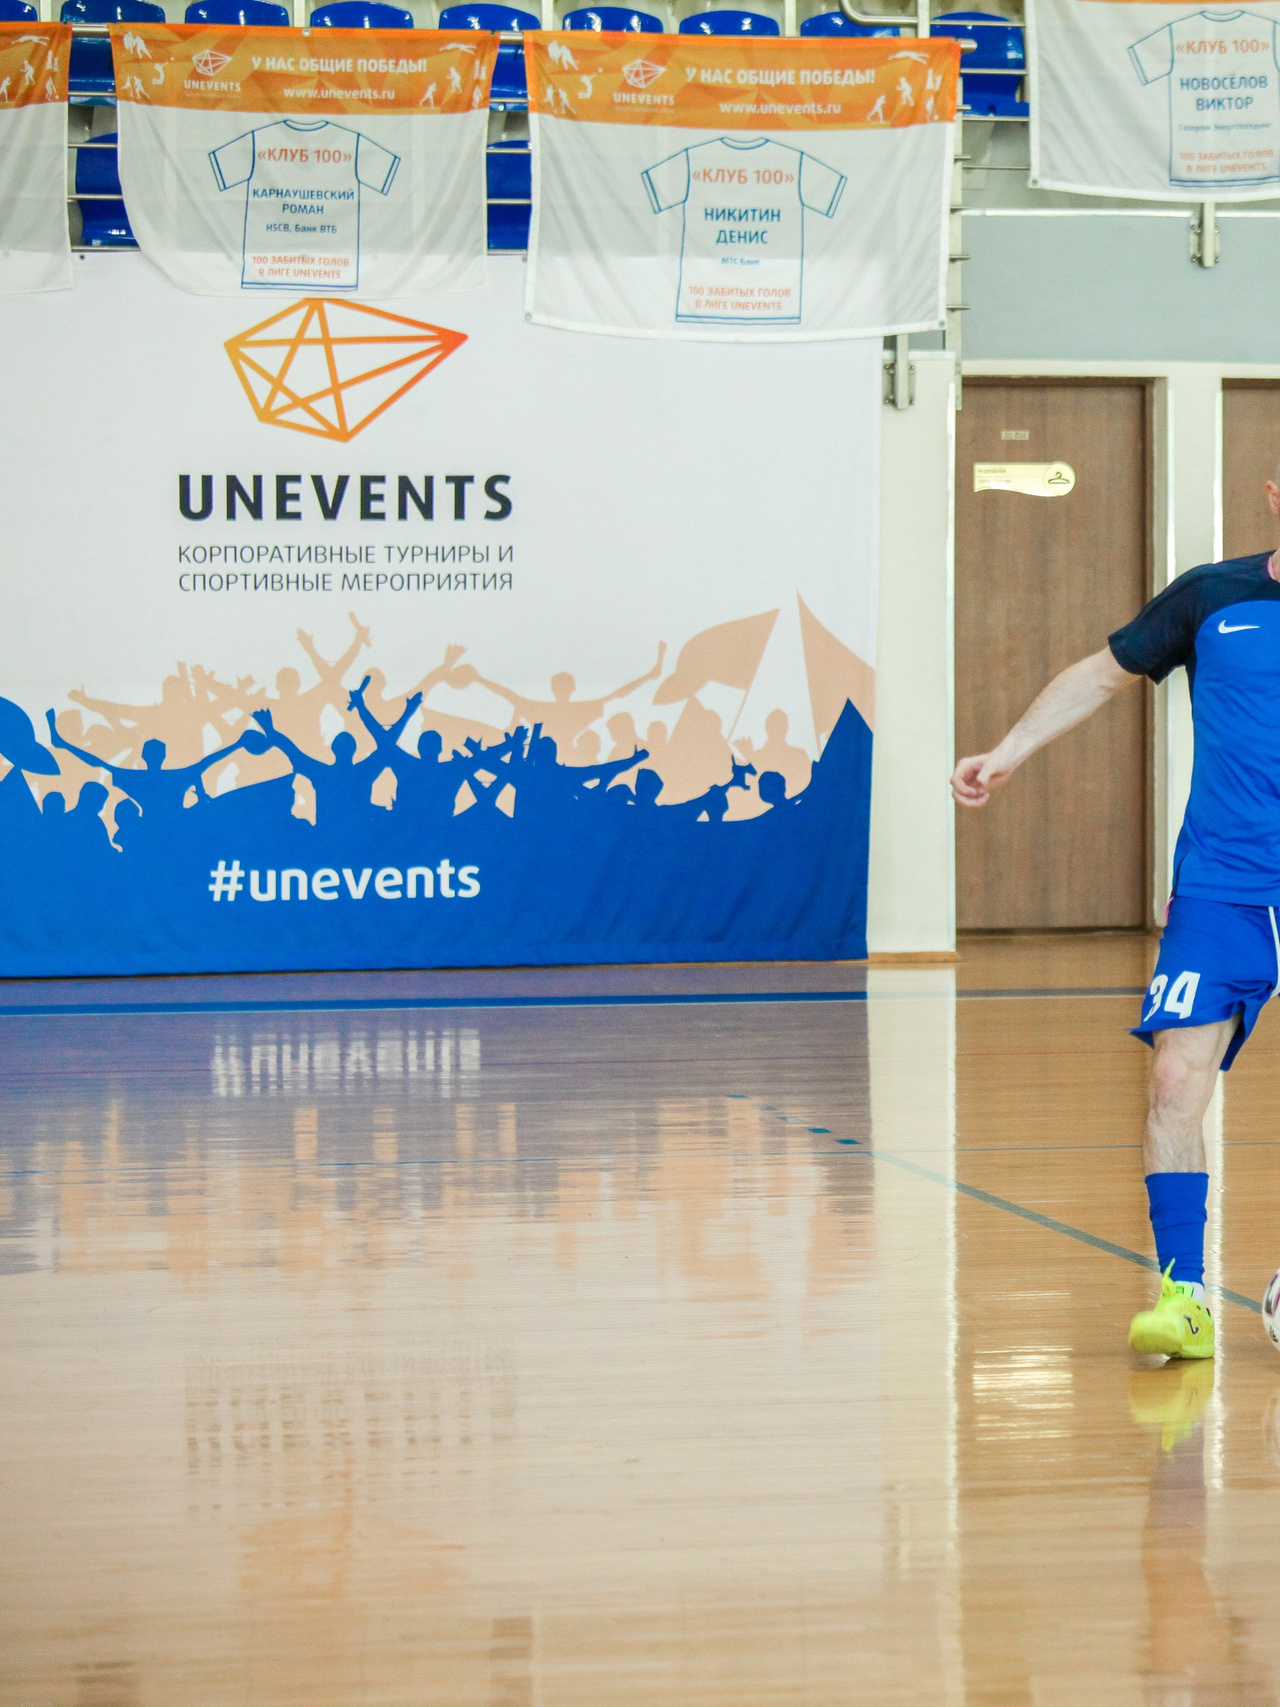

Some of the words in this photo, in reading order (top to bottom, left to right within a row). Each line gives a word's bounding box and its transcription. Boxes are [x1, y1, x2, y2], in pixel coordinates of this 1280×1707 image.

[1176, 39, 1228, 55] «КЛУБ
[1232, 38, 1270, 54] 100»
[252, 57, 262, 71] У
[266, 57, 294, 71] НАС
[299, 57, 353, 74] ОБЩИЕ
[357, 58, 427, 74] ПОБЕДЫ!
[685, 67, 697, 82] У
[701, 67, 732, 84] НАС
[737, 69, 795, 86] ОБЩИЕ
[800, 69, 875, 86] ПОБЕДЫ!
[1180, 74, 1268, 91] НОВОСЁЛОВ
[184, 79, 241, 92] UNEVENTS
[284, 88, 395, 100] www.unevents.ru
[613, 92, 675, 106] UNEVENTS
[719, 101, 841, 115] www.unevents.ru
[1196, 97, 1254, 112] ВИКТОР
[257, 148, 308, 162] «КЛУБ
[314, 150, 352, 163] 100»
[692, 168, 748, 184] «КЛУБ
[754, 169, 794, 184] 100»
[253, 188, 354, 201] КАРНАУШЕВСКИЙ
[282, 204, 324, 214] РОМАН
[704, 207, 781, 223] НИКИТИН
[716, 230, 768, 245] ДЕНИС
[252, 256, 268, 265] 100
[271, 256, 315, 266] ЗАБИТЫХ
[319, 257, 350, 267] ГОЛОВ
[268, 268, 290, 278] ЛИГЕ
[294, 268, 341, 278] UNEVENTS
[689, 286, 704, 296] 100
[707, 286, 755, 297] ЗАБИТЫХ
[758, 287, 791, 298] ГОЛОВ
[704, 299, 728, 310] ЛИГЕ
[731, 301, 783, 311] UNEVENTS
[179, 474, 514, 521] UNEVENTS
[179, 545, 376, 564] КОРПОРАТИВНЫЕ
[384, 545, 490, 564] ТУРНИРЫ
[498, 545, 514, 563] И
[179, 573, 333, 592] СПОРТИВНЫЕ
[341, 572, 513, 591] МЕРОПРИЯТИЯ
[208, 859, 481, 902] #unevents
[1143, 970, 1201, 1022] 34
